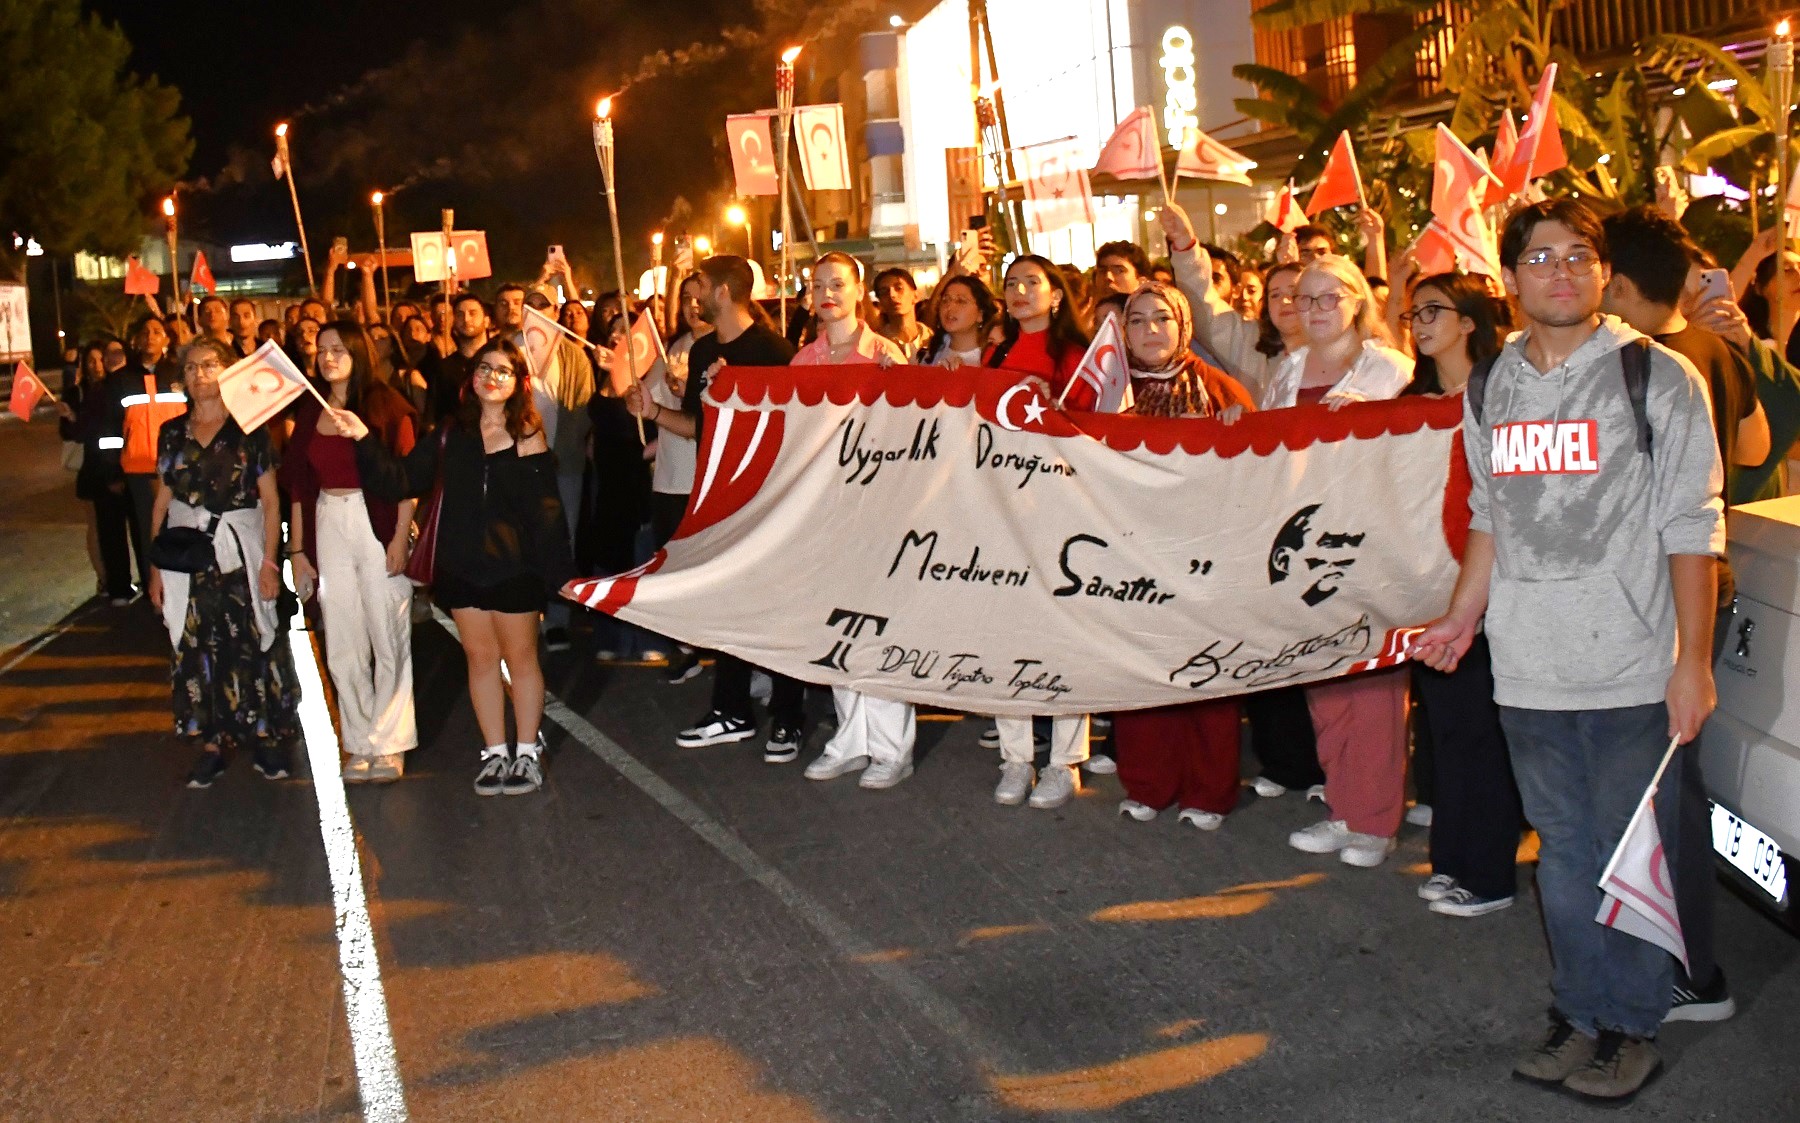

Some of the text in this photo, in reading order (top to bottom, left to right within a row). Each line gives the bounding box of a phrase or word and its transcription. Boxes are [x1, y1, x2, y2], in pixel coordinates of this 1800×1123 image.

[1491, 422, 1597, 474] MARVEL
[888, 529, 1030, 587] Merdiveni
[877, 645, 940, 679] DAÜ
